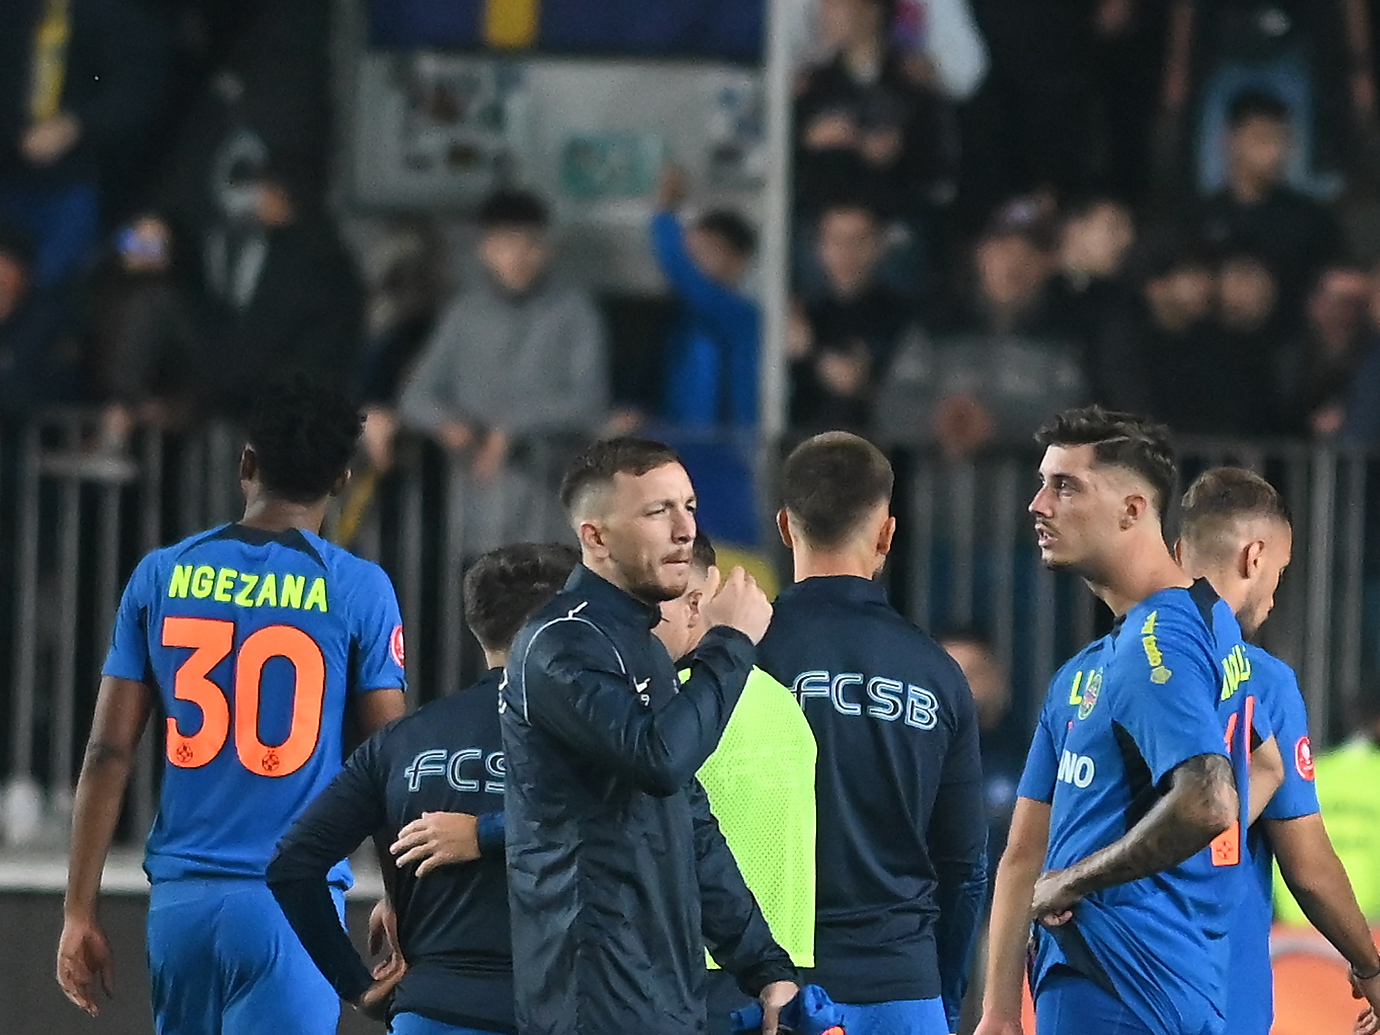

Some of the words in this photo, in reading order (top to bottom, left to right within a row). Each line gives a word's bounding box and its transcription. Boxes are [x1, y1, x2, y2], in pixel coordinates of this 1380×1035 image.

[168, 564, 329, 612] NGEZANA
[161, 616, 327, 778] 30
[788, 671, 940, 731] FCSB
[404, 749, 506, 793] FCS
